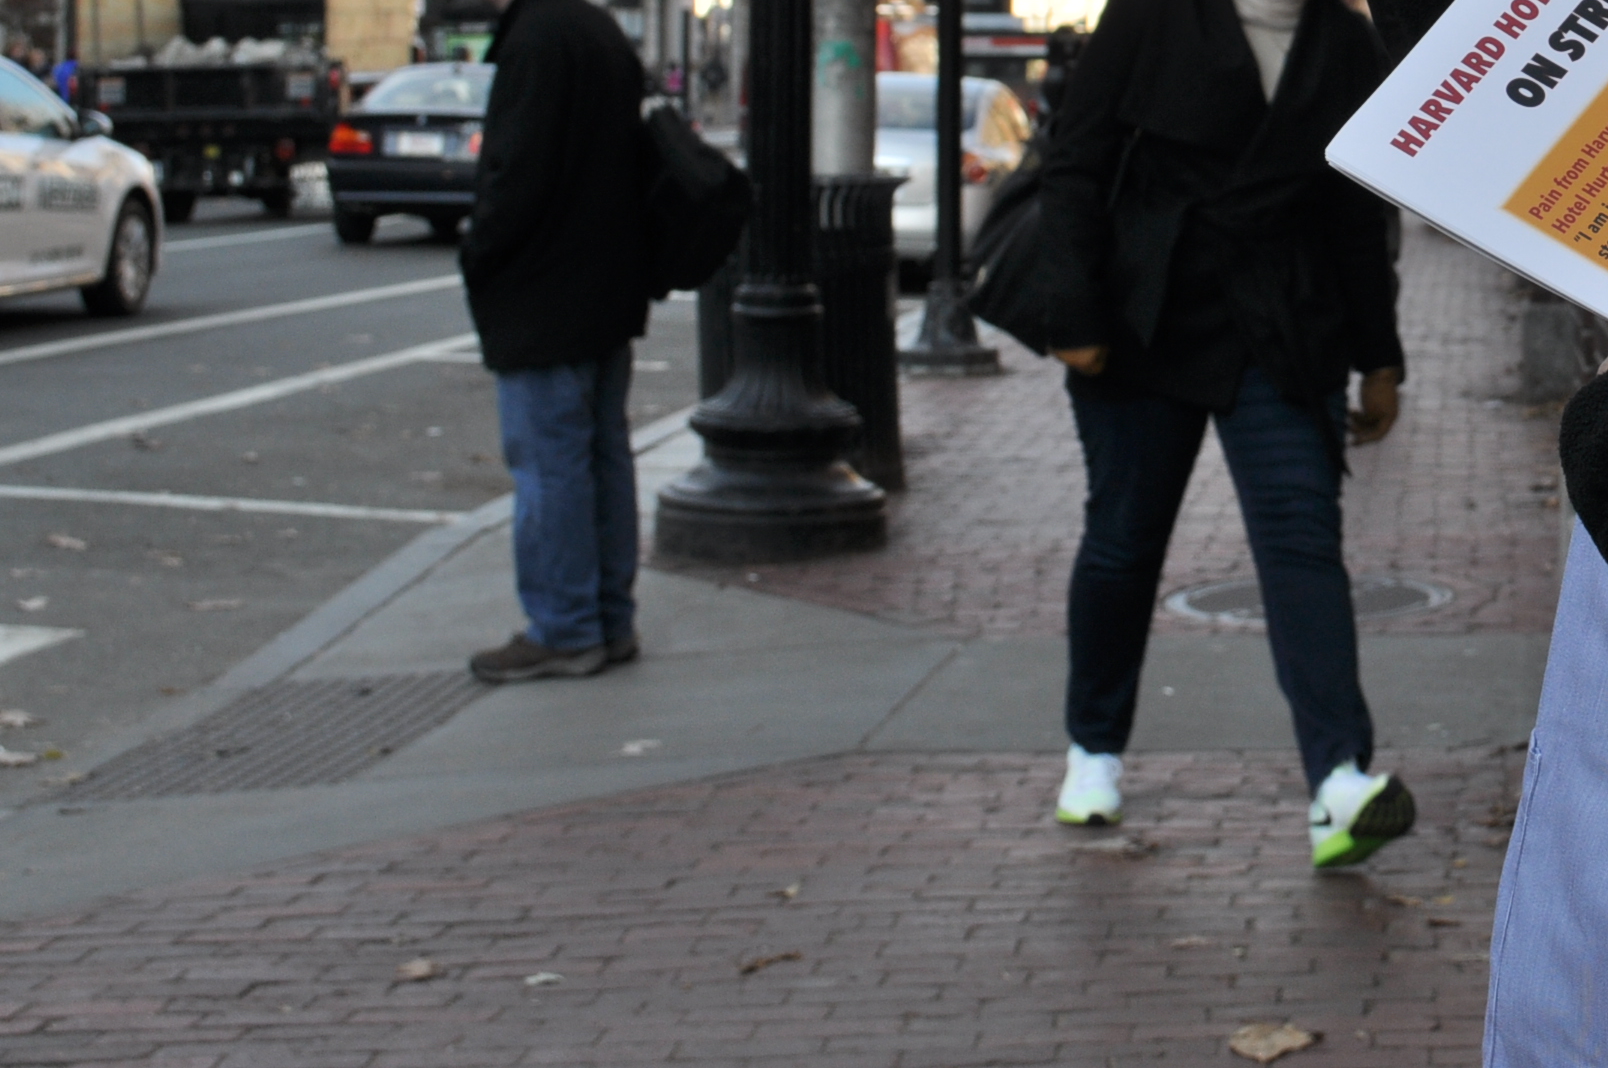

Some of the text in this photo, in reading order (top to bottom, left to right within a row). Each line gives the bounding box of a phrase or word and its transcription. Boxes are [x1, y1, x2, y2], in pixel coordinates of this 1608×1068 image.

[1390, 36, 1506, 158] HARVARD
[1505, 52, 1569, 108] ON
[1528, 189, 1563, 220] Pain
[1553, 157, 1590, 190] from
[1551, 193, 1591, 234] Hotel
